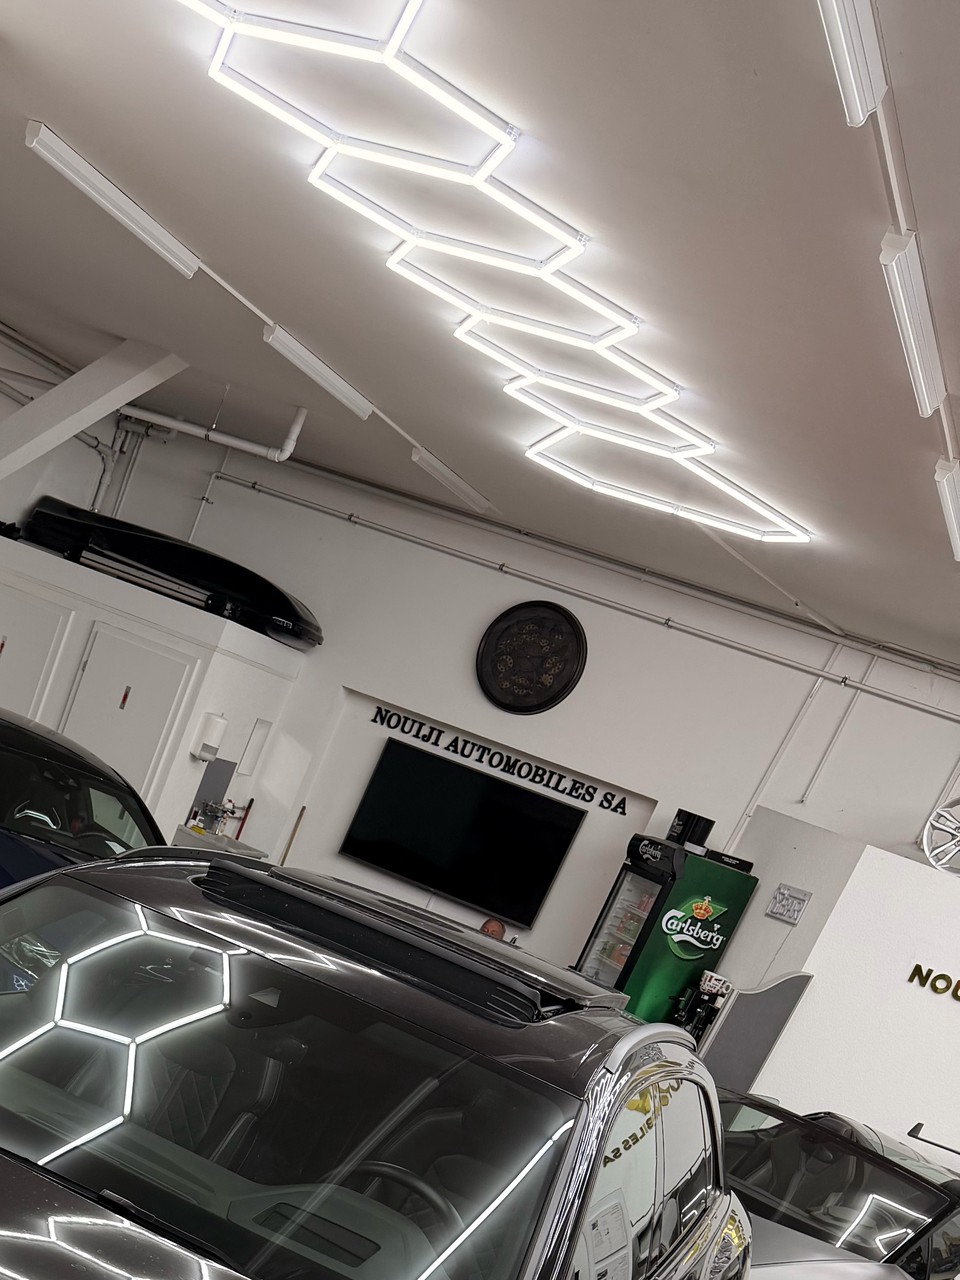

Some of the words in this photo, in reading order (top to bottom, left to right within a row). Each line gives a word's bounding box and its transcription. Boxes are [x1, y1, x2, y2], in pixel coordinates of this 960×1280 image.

[370, 706, 445, 747] NOUIJI
[445, 736, 598, 803] AUTOMOBILES
[599, 792, 628, 816] SA
[638, 840, 662, 861] Carlsberg
[661, 908, 725, 949] Carlsberg
